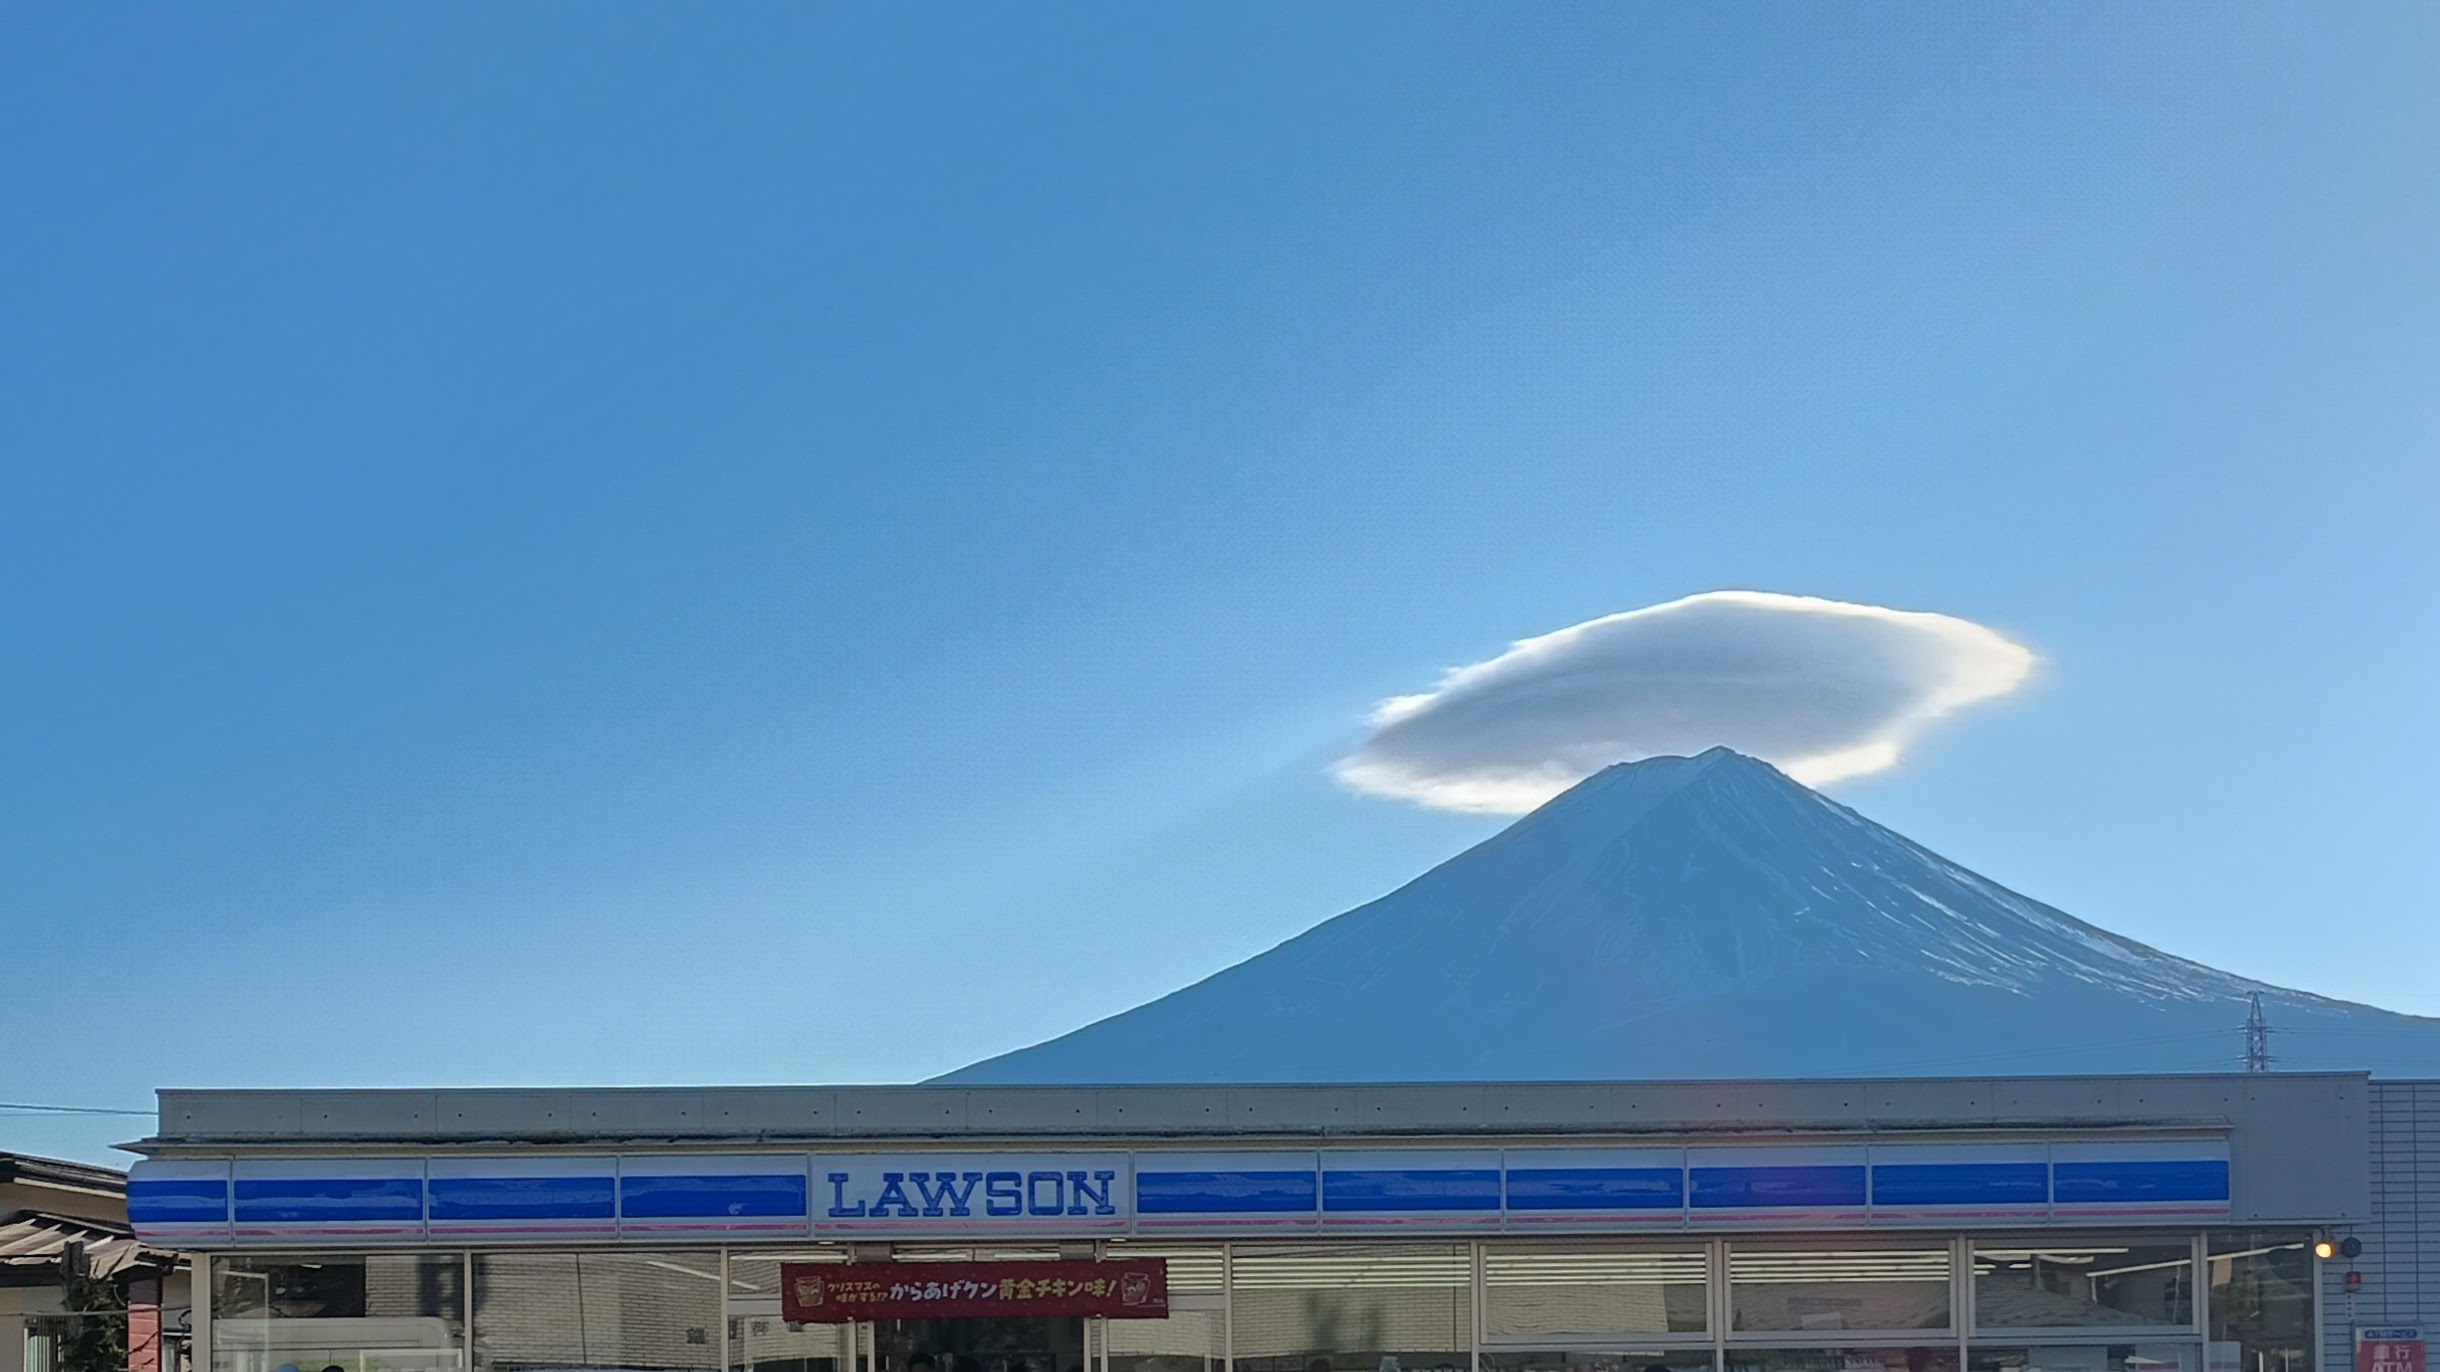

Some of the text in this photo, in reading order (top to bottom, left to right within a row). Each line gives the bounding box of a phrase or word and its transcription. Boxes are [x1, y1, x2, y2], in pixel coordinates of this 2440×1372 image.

[827, 1171, 1116, 1217] LAWSON
[2374, 1345, 2410, 1360] 銀行
[2371, 1362, 2412, 1372] ATM
